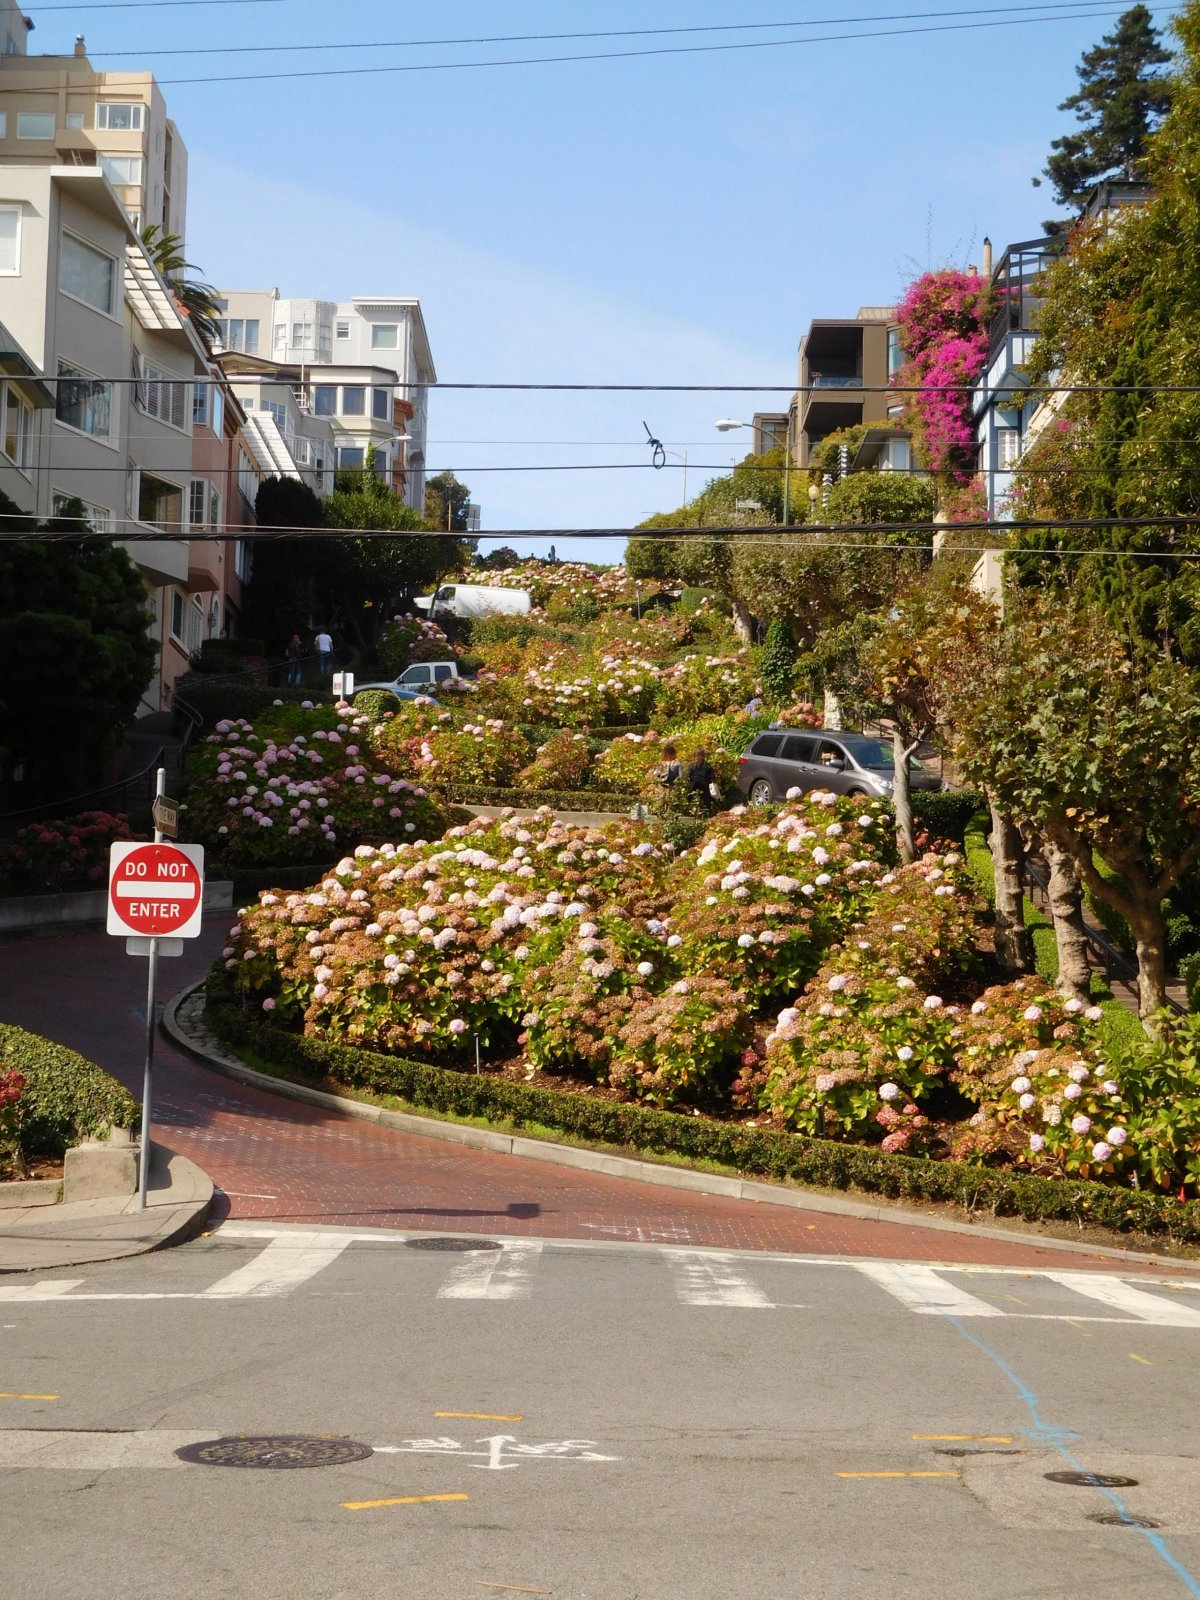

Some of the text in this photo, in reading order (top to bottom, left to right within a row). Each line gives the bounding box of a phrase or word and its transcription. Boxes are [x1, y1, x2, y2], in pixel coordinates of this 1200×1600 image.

[125, 862, 189, 877] DO NOT
[129, 902, 180, 918] ENTER
